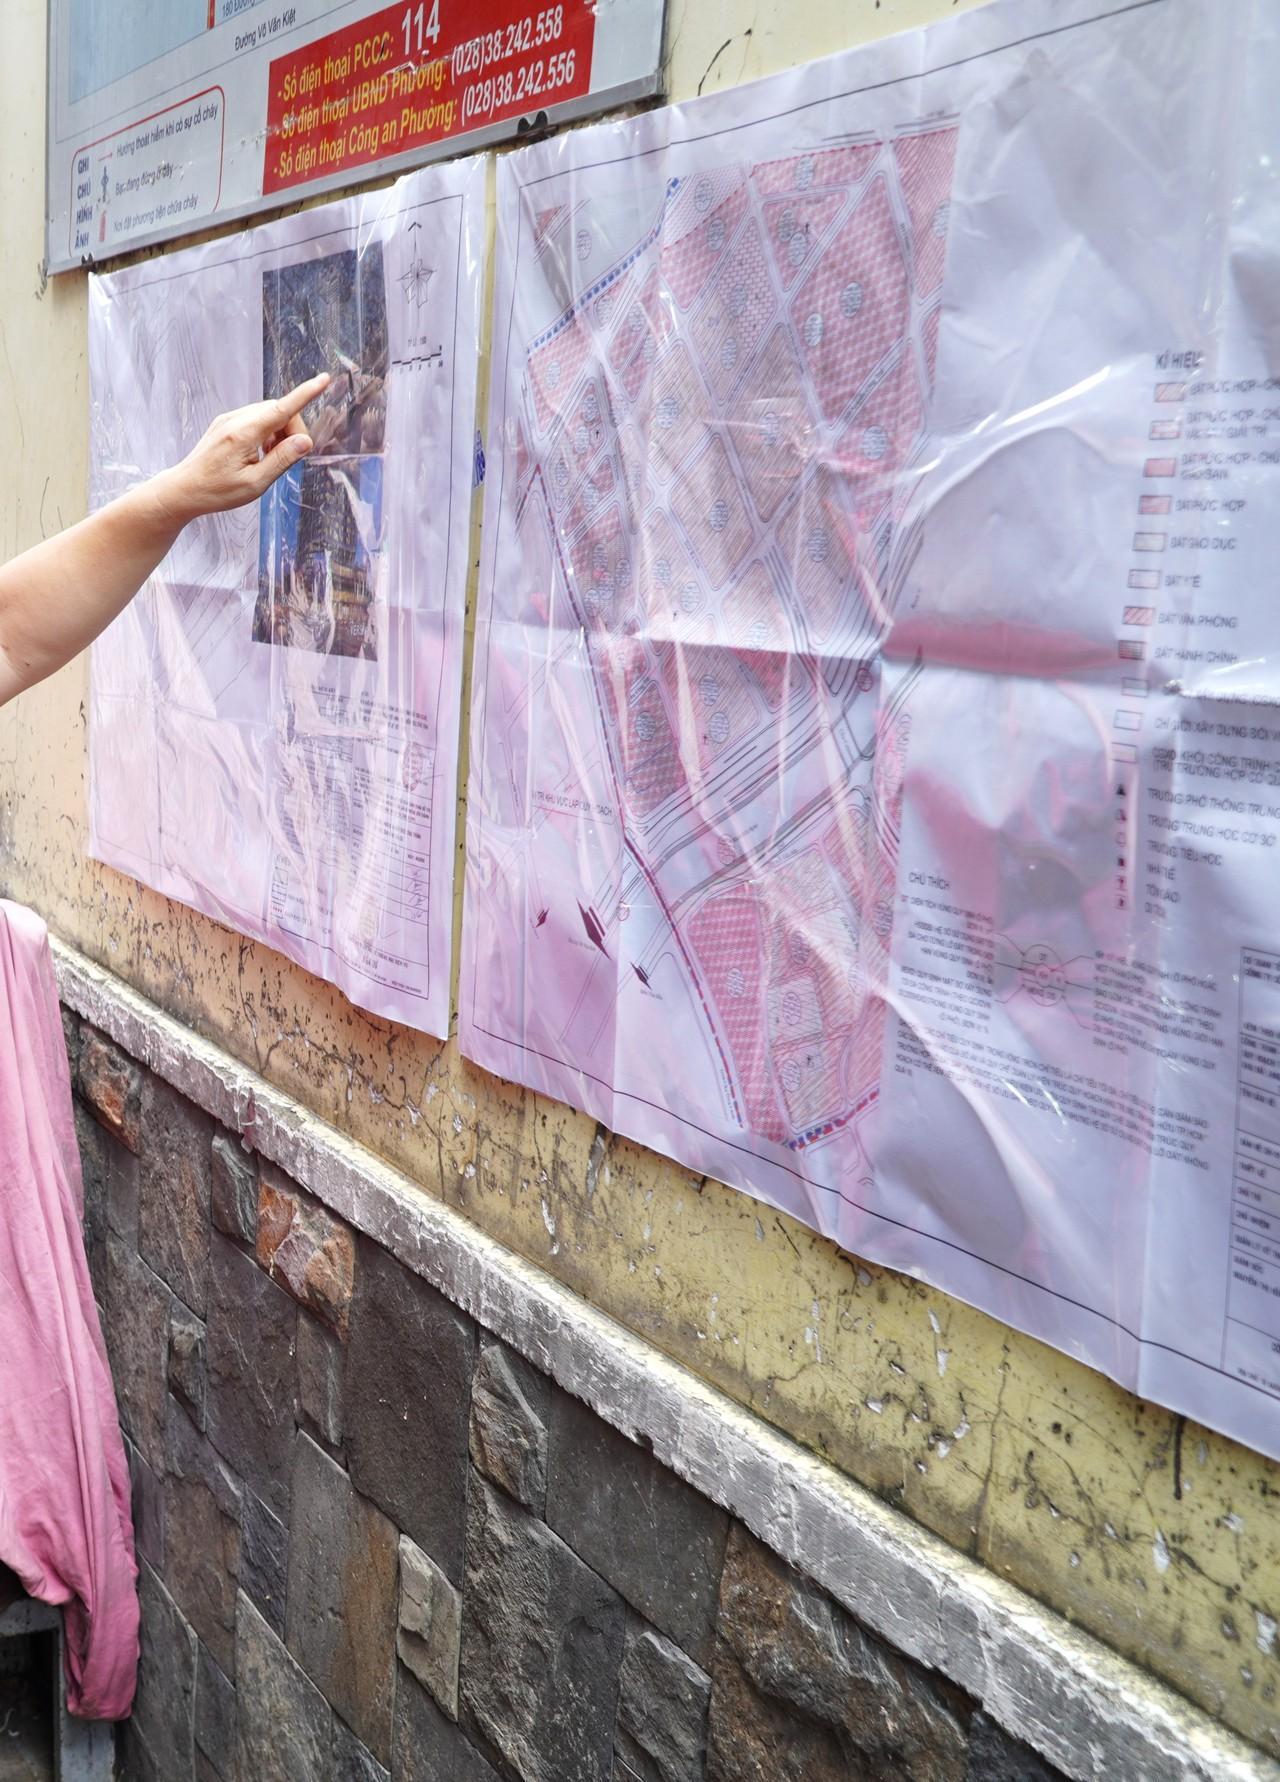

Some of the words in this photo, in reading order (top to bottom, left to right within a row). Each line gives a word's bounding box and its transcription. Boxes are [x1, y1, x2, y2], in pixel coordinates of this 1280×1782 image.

[282, 8, 297, 28] Kiệt
[283, 65, 298, 102] Số
[299, 62, 321, 97] điện
[324, 47, 351, 84] thoại
[401, 0, 441, 56] 114
[297, 104, 320, 138] điện
[322, 89, 350, 125] thoại
[352, 73, 389, 114] UBND
[451, 4, 564, 86] (028)38.242.558
[165, 121, 175, 140] khi
[202, 103, 219, 121] cháy
[279, 142, 293, 179] Số
[294, 142, 316, 177] điện
[319, 130, 347, 166] thoại
[348, 123, 379, 155] Công
[381, 119, 397, 145] an
[400, 98, 458, 139] Phường:
[461, 49, 576, 127] (028)38.242.556
[77, 156, 90, 174] GHI
[77, 180, 91, 199] CHÚ
[183, 192, 199, 211] cháy
[75, 229, 89, 248] ẢNH
